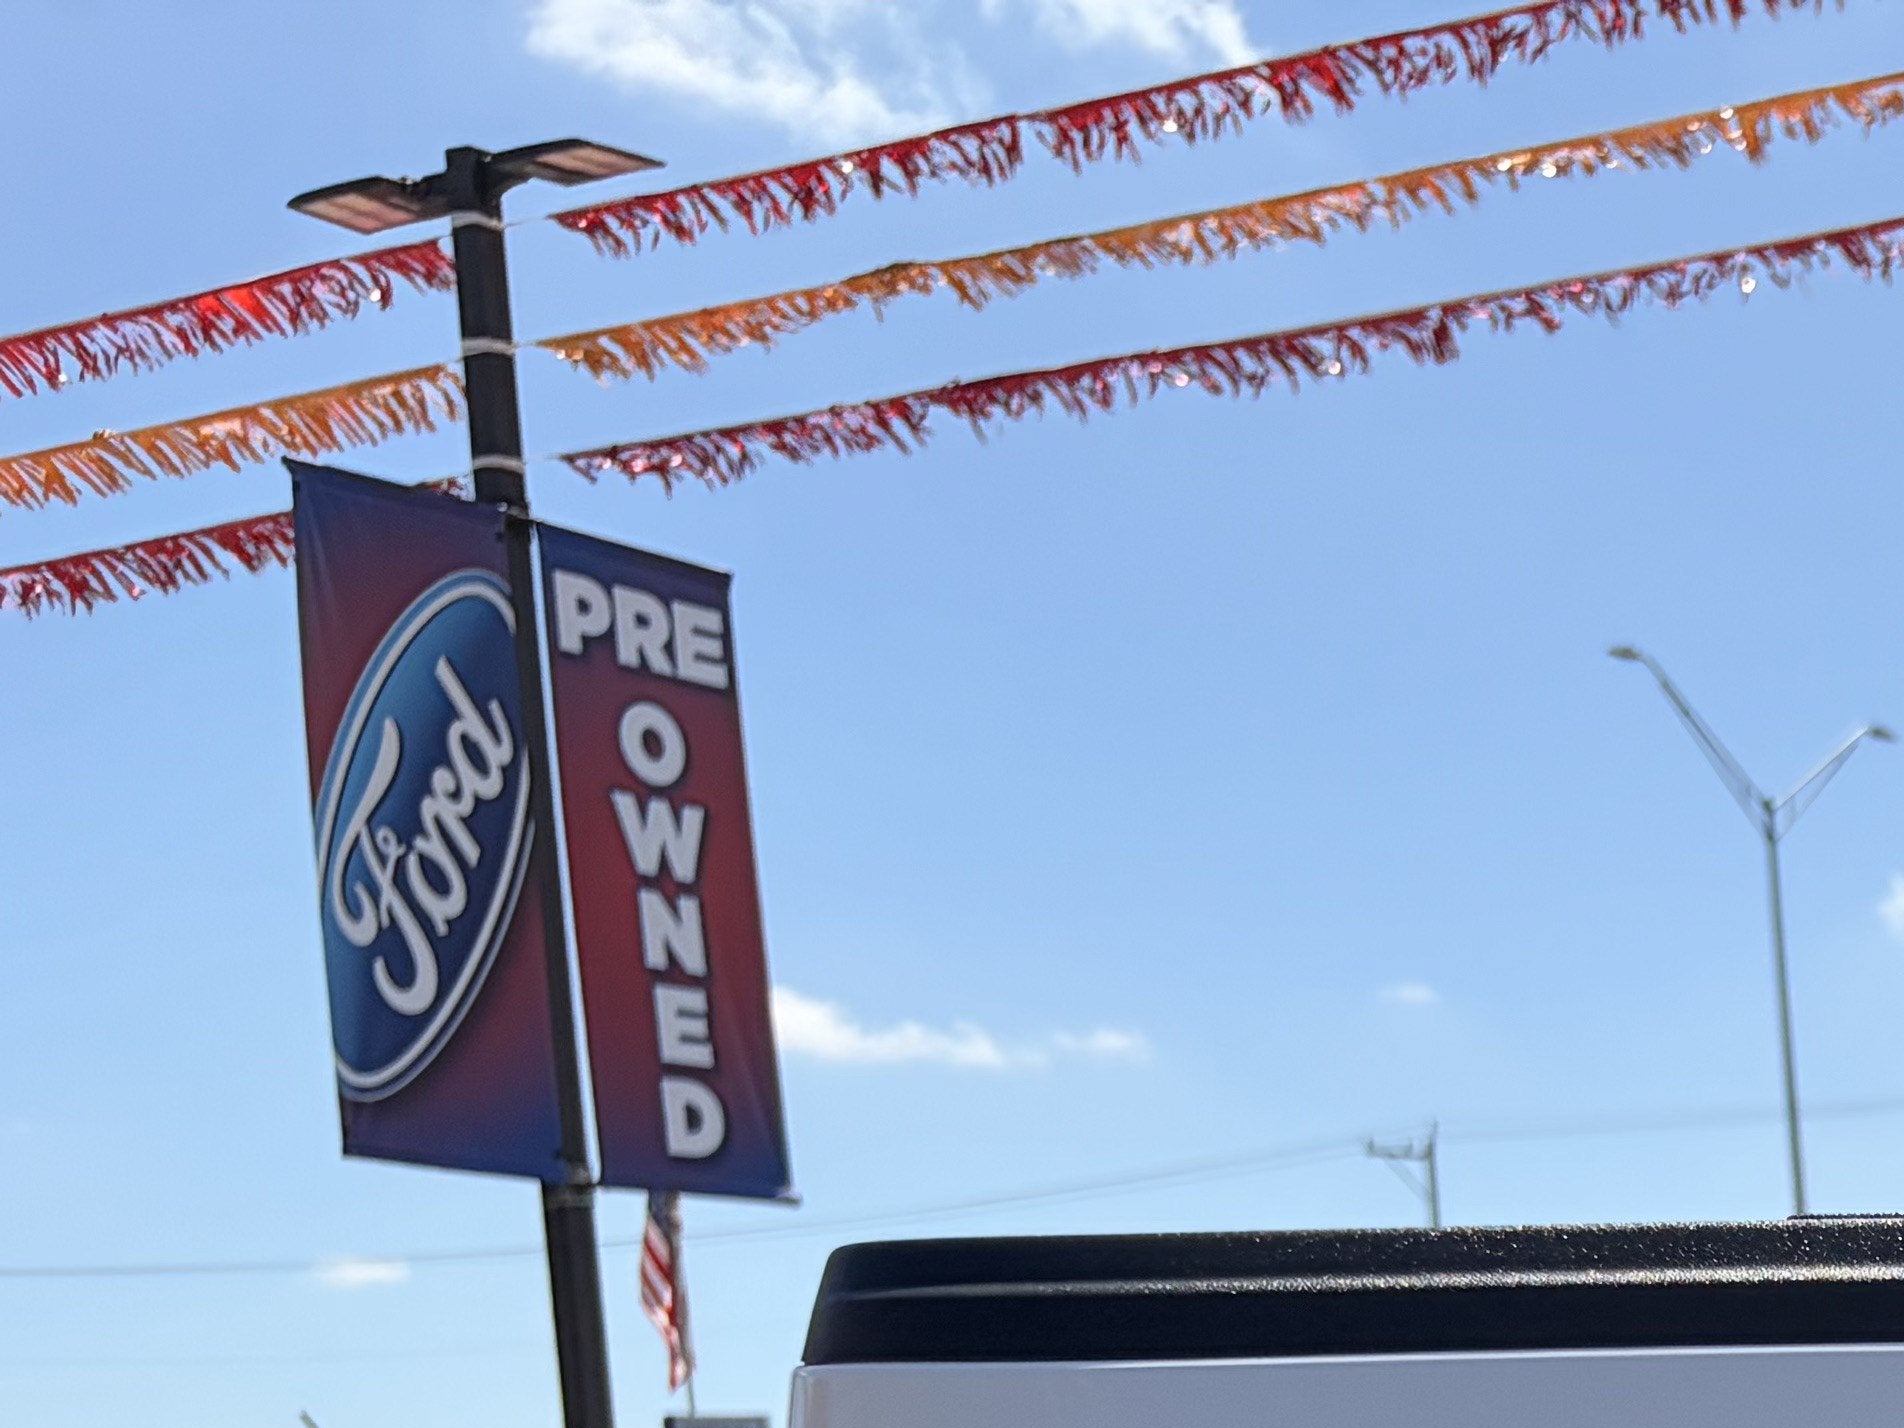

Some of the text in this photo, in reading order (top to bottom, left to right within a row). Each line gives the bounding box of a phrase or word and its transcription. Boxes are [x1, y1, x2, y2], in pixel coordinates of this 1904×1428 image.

[554, 571, 728, 688] PRE
[335, 656, 512, 1015] Ford
[612, 703, 725, 1158] OWNED
